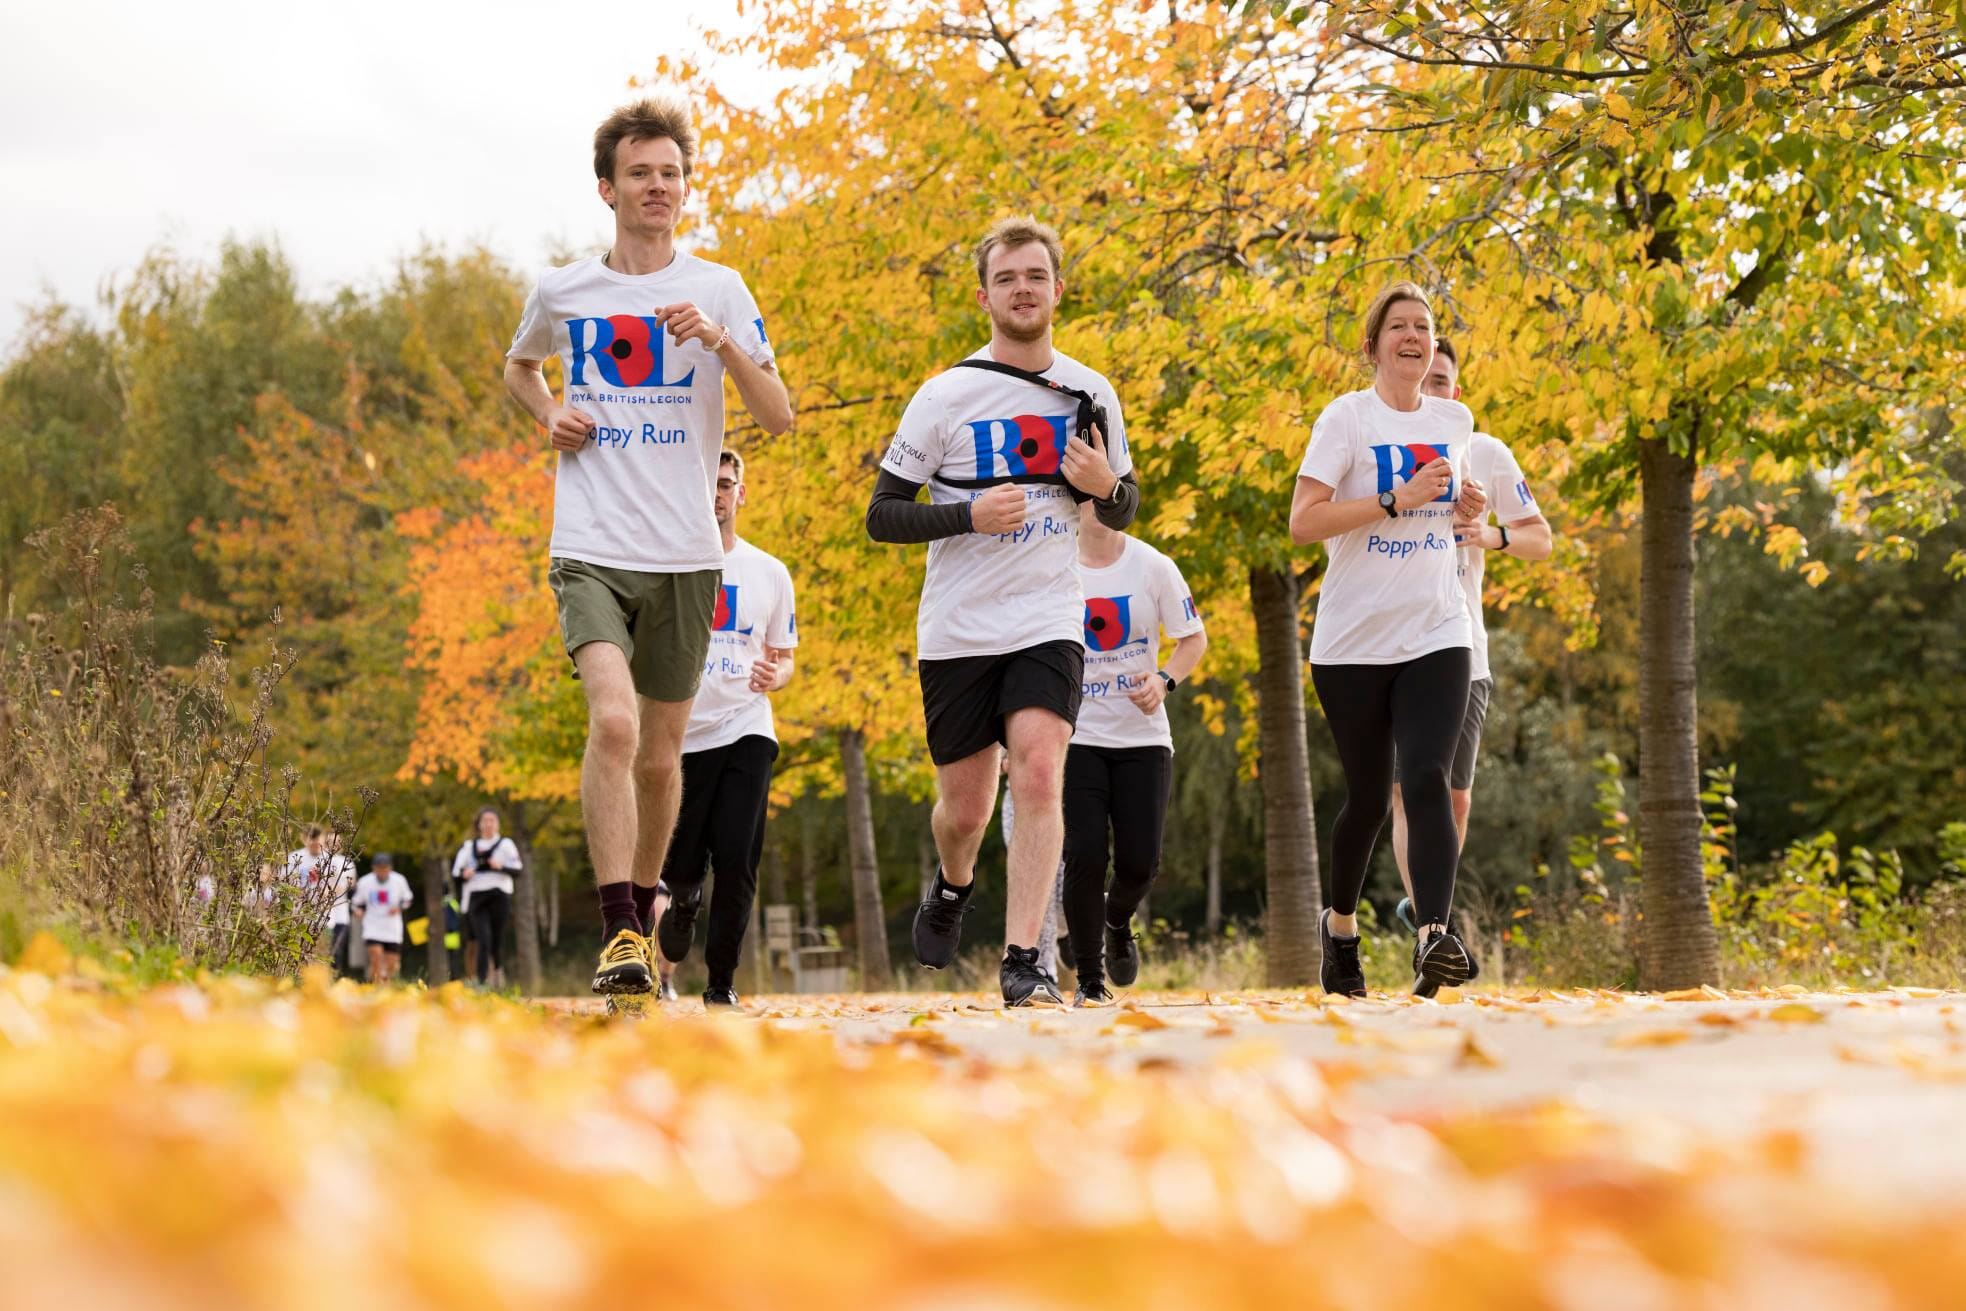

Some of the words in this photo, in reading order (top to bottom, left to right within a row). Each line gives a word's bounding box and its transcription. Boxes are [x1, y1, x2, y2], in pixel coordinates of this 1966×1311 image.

[599, 393, 646, 404] BRITISH
[650, 395, 692, 404] LEGION
[589, 424, 632, 448] oppy
[642, 423, 685, 444] Run
[1026, 490, 1050, 499] TISH
[722, 657, 744, 674] Run
